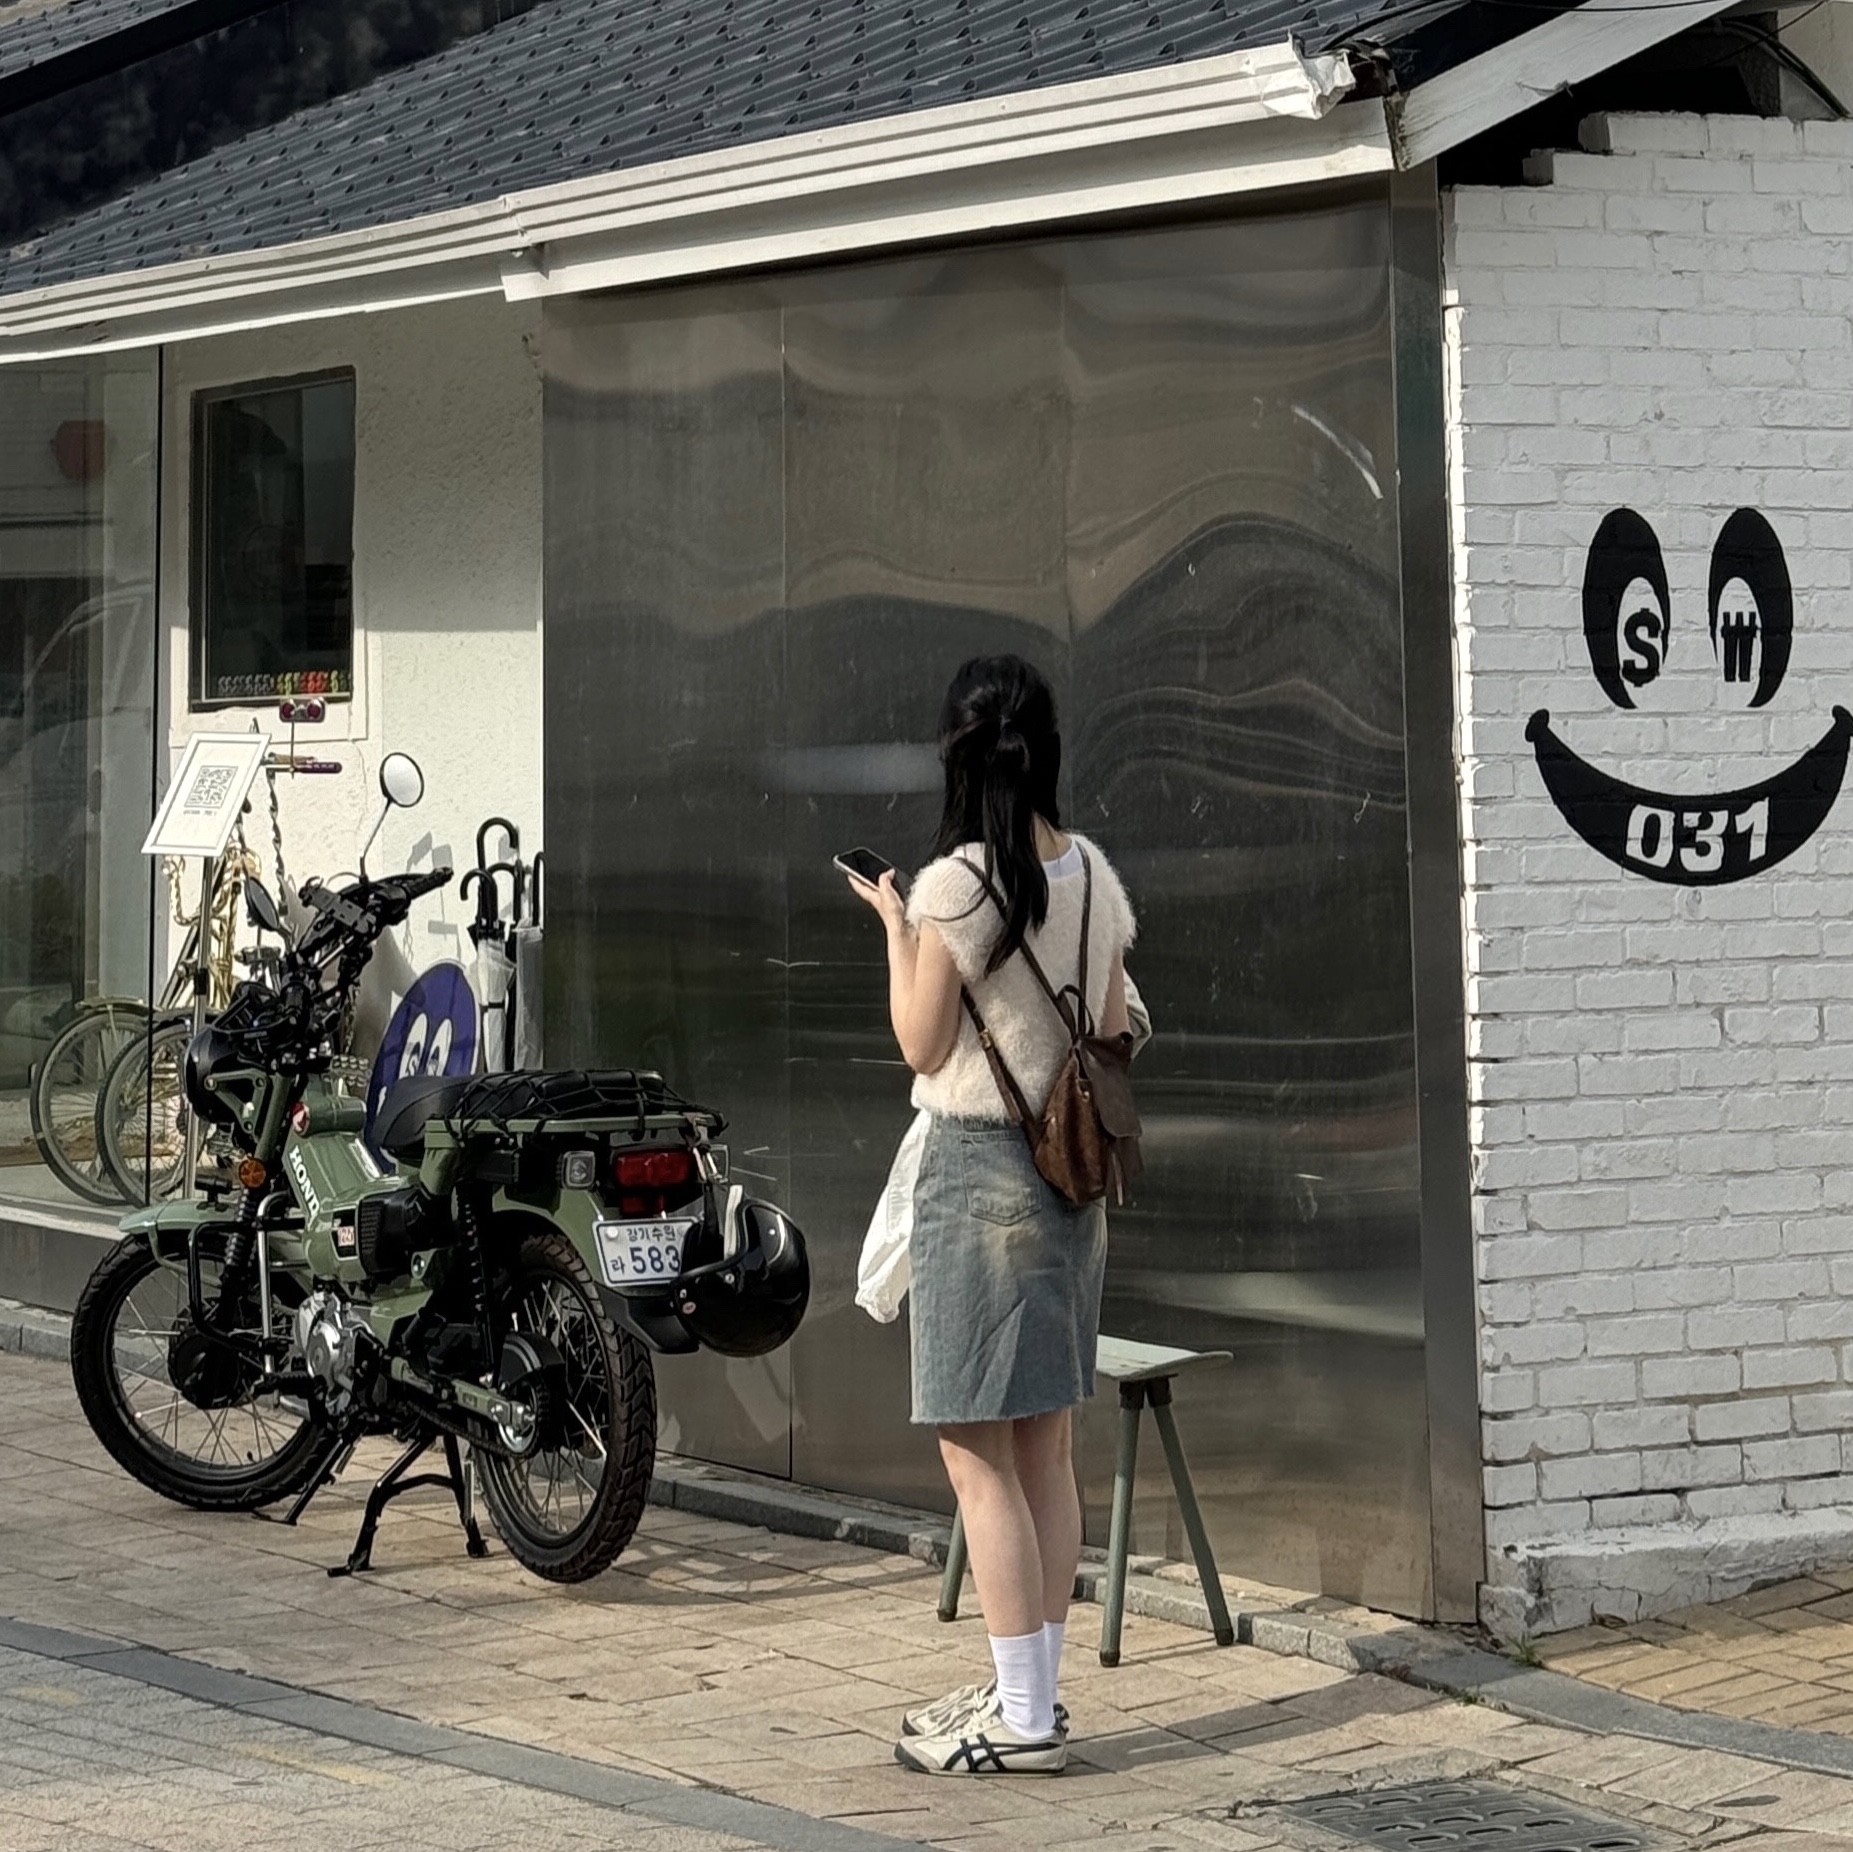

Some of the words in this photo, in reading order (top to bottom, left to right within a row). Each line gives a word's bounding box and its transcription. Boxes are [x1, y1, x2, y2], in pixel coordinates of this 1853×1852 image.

[1625, 797, 1769, 872] 031
[610, 1256, 625, 1275] 라
[629, 1244, 681, 1275] 583
